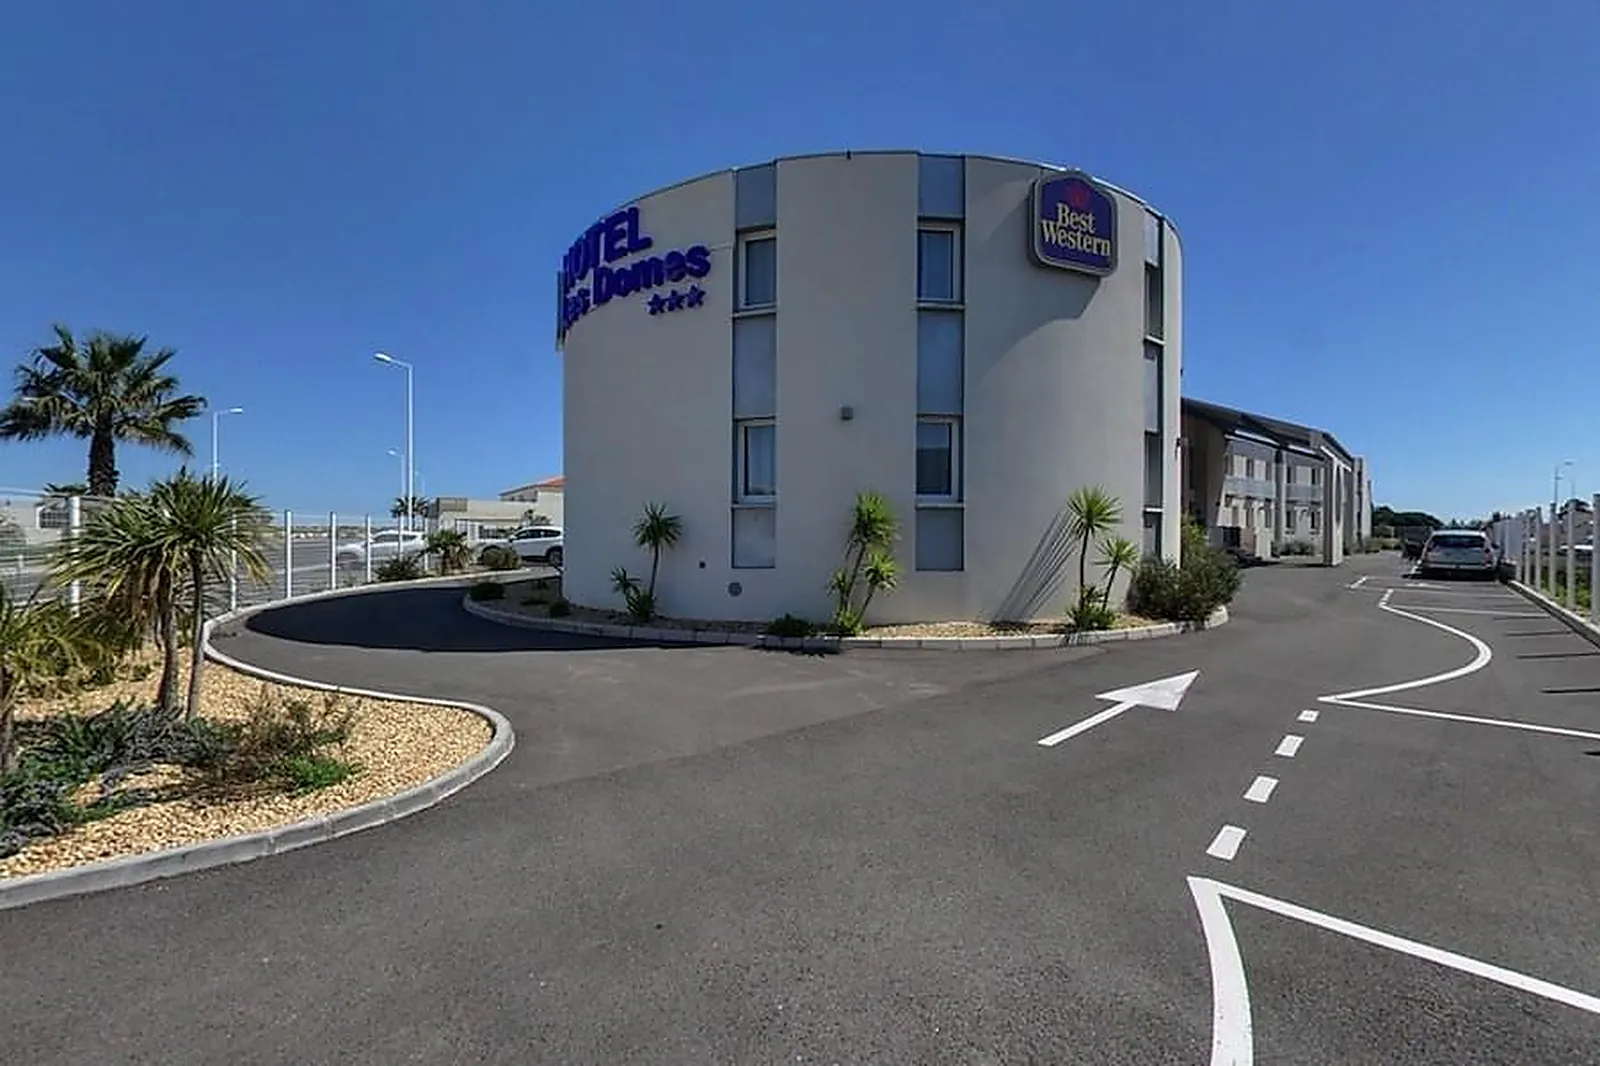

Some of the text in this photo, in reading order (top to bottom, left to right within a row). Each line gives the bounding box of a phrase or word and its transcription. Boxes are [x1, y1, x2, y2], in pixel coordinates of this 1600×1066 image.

[1041, 219, 1111, 257] Western
[1056, 202, 1096, 234] Best
[562, 206, 653, 294] HOTEL
[593, 245, 711, 306] Domes
